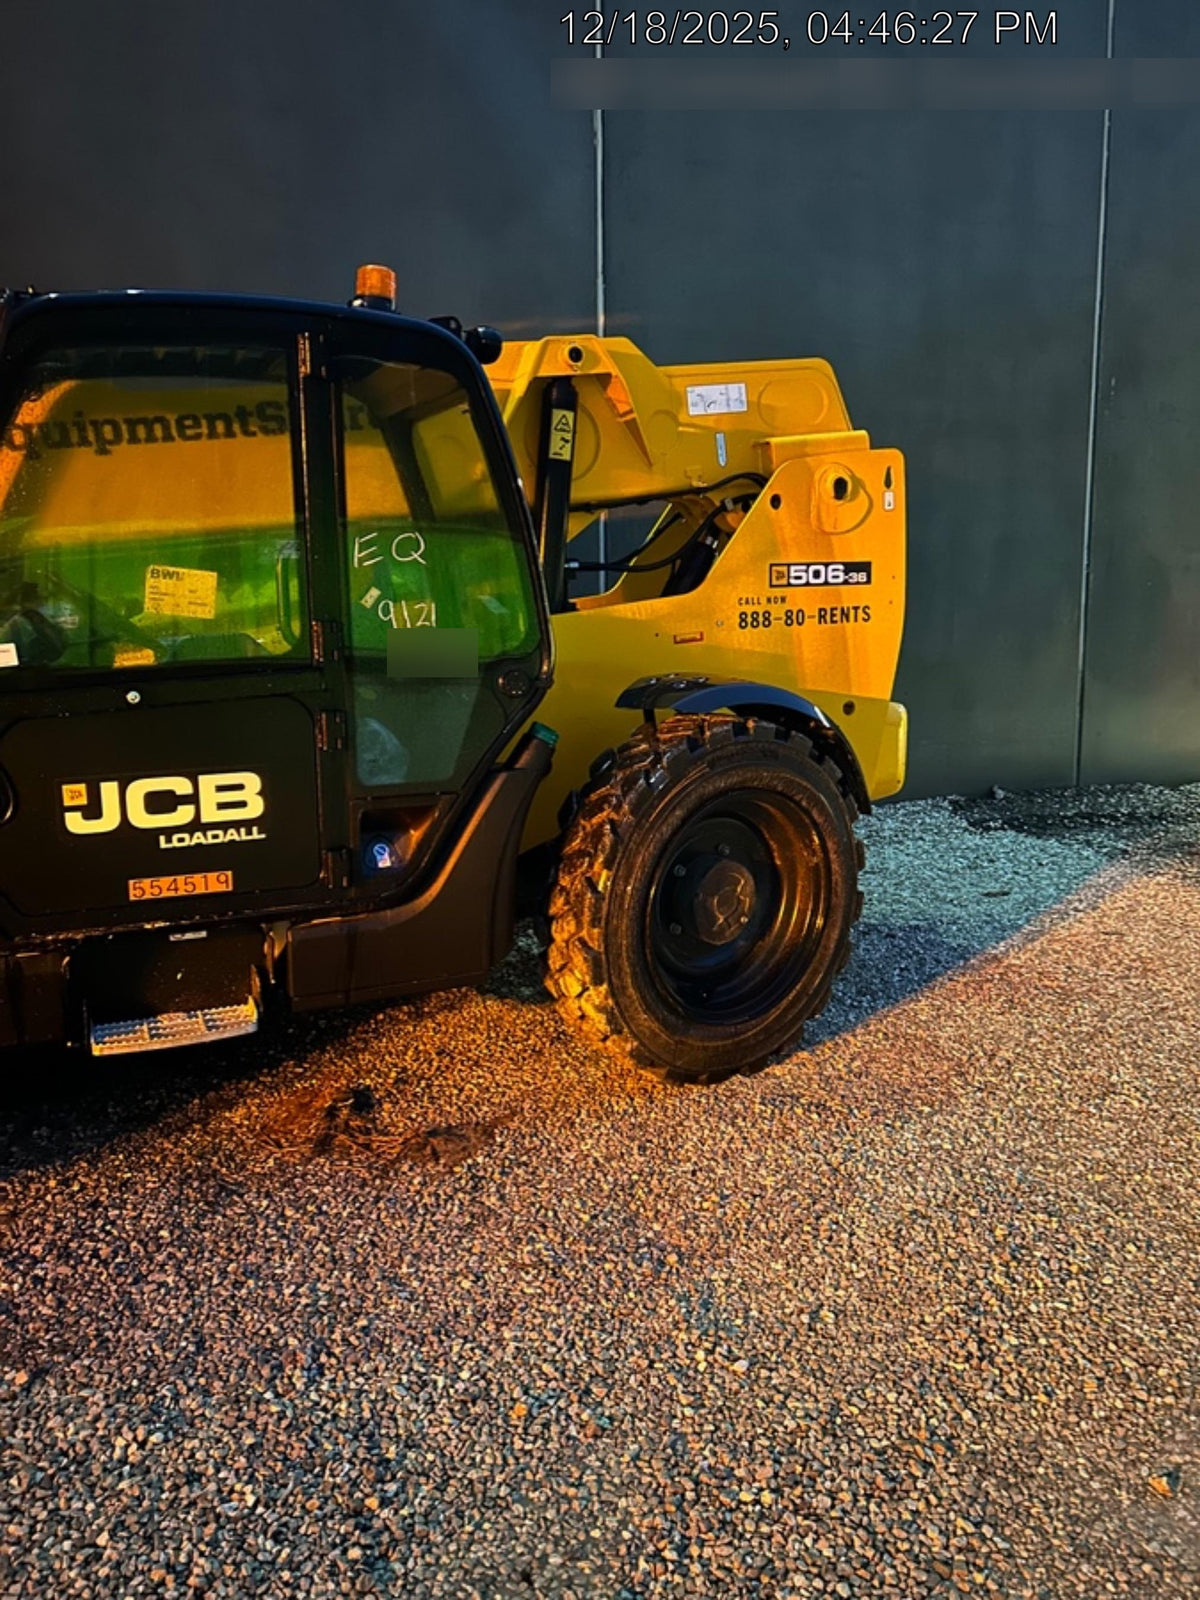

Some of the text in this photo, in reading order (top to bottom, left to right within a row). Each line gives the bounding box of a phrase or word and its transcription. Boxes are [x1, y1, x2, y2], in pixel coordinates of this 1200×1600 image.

[352, 531, 427, 568] EQ
[737, 596, 787, 606] CALL NOW
[738, 605, 872, 630] 888-80-RENTS
[64, 771, 265, 835] JCB
[158, 826, 266, 849] LOADALL
[131, 872, 231, 899] 554519
